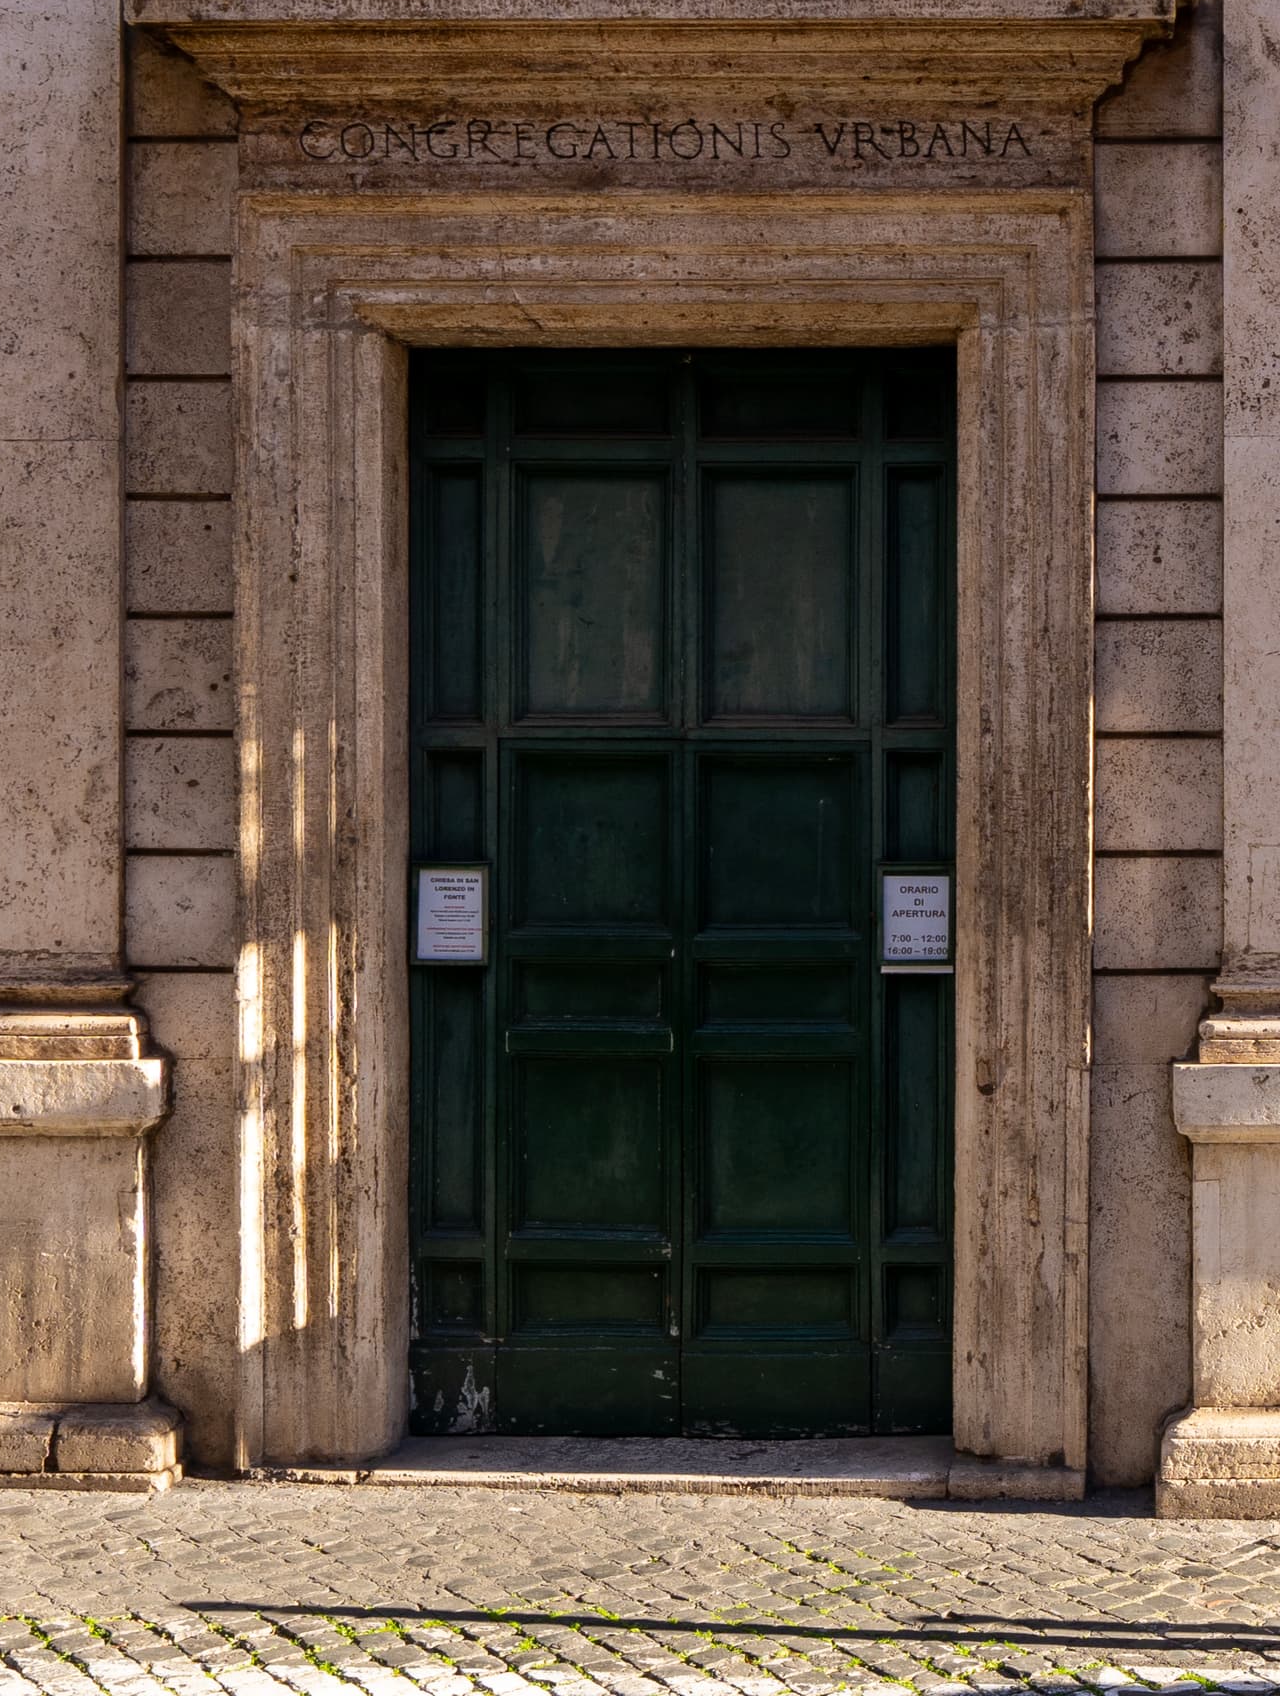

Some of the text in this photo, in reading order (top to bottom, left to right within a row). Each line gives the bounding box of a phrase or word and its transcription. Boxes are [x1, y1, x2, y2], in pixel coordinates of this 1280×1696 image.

[299, 119, 1033, 161] CONGREGATIONIS VRBANA
[899, 886, 939, 894] ORARIO
[914, 898, 924, 906] DI
[891, 910, 946, 918] APERTURA
[891, 934, 912, 943] 7:00
[921, 934, 947, 943] 12:00
[888, 947, 913, 956] 16:00
[922, 947, 948, 956] 19:00
